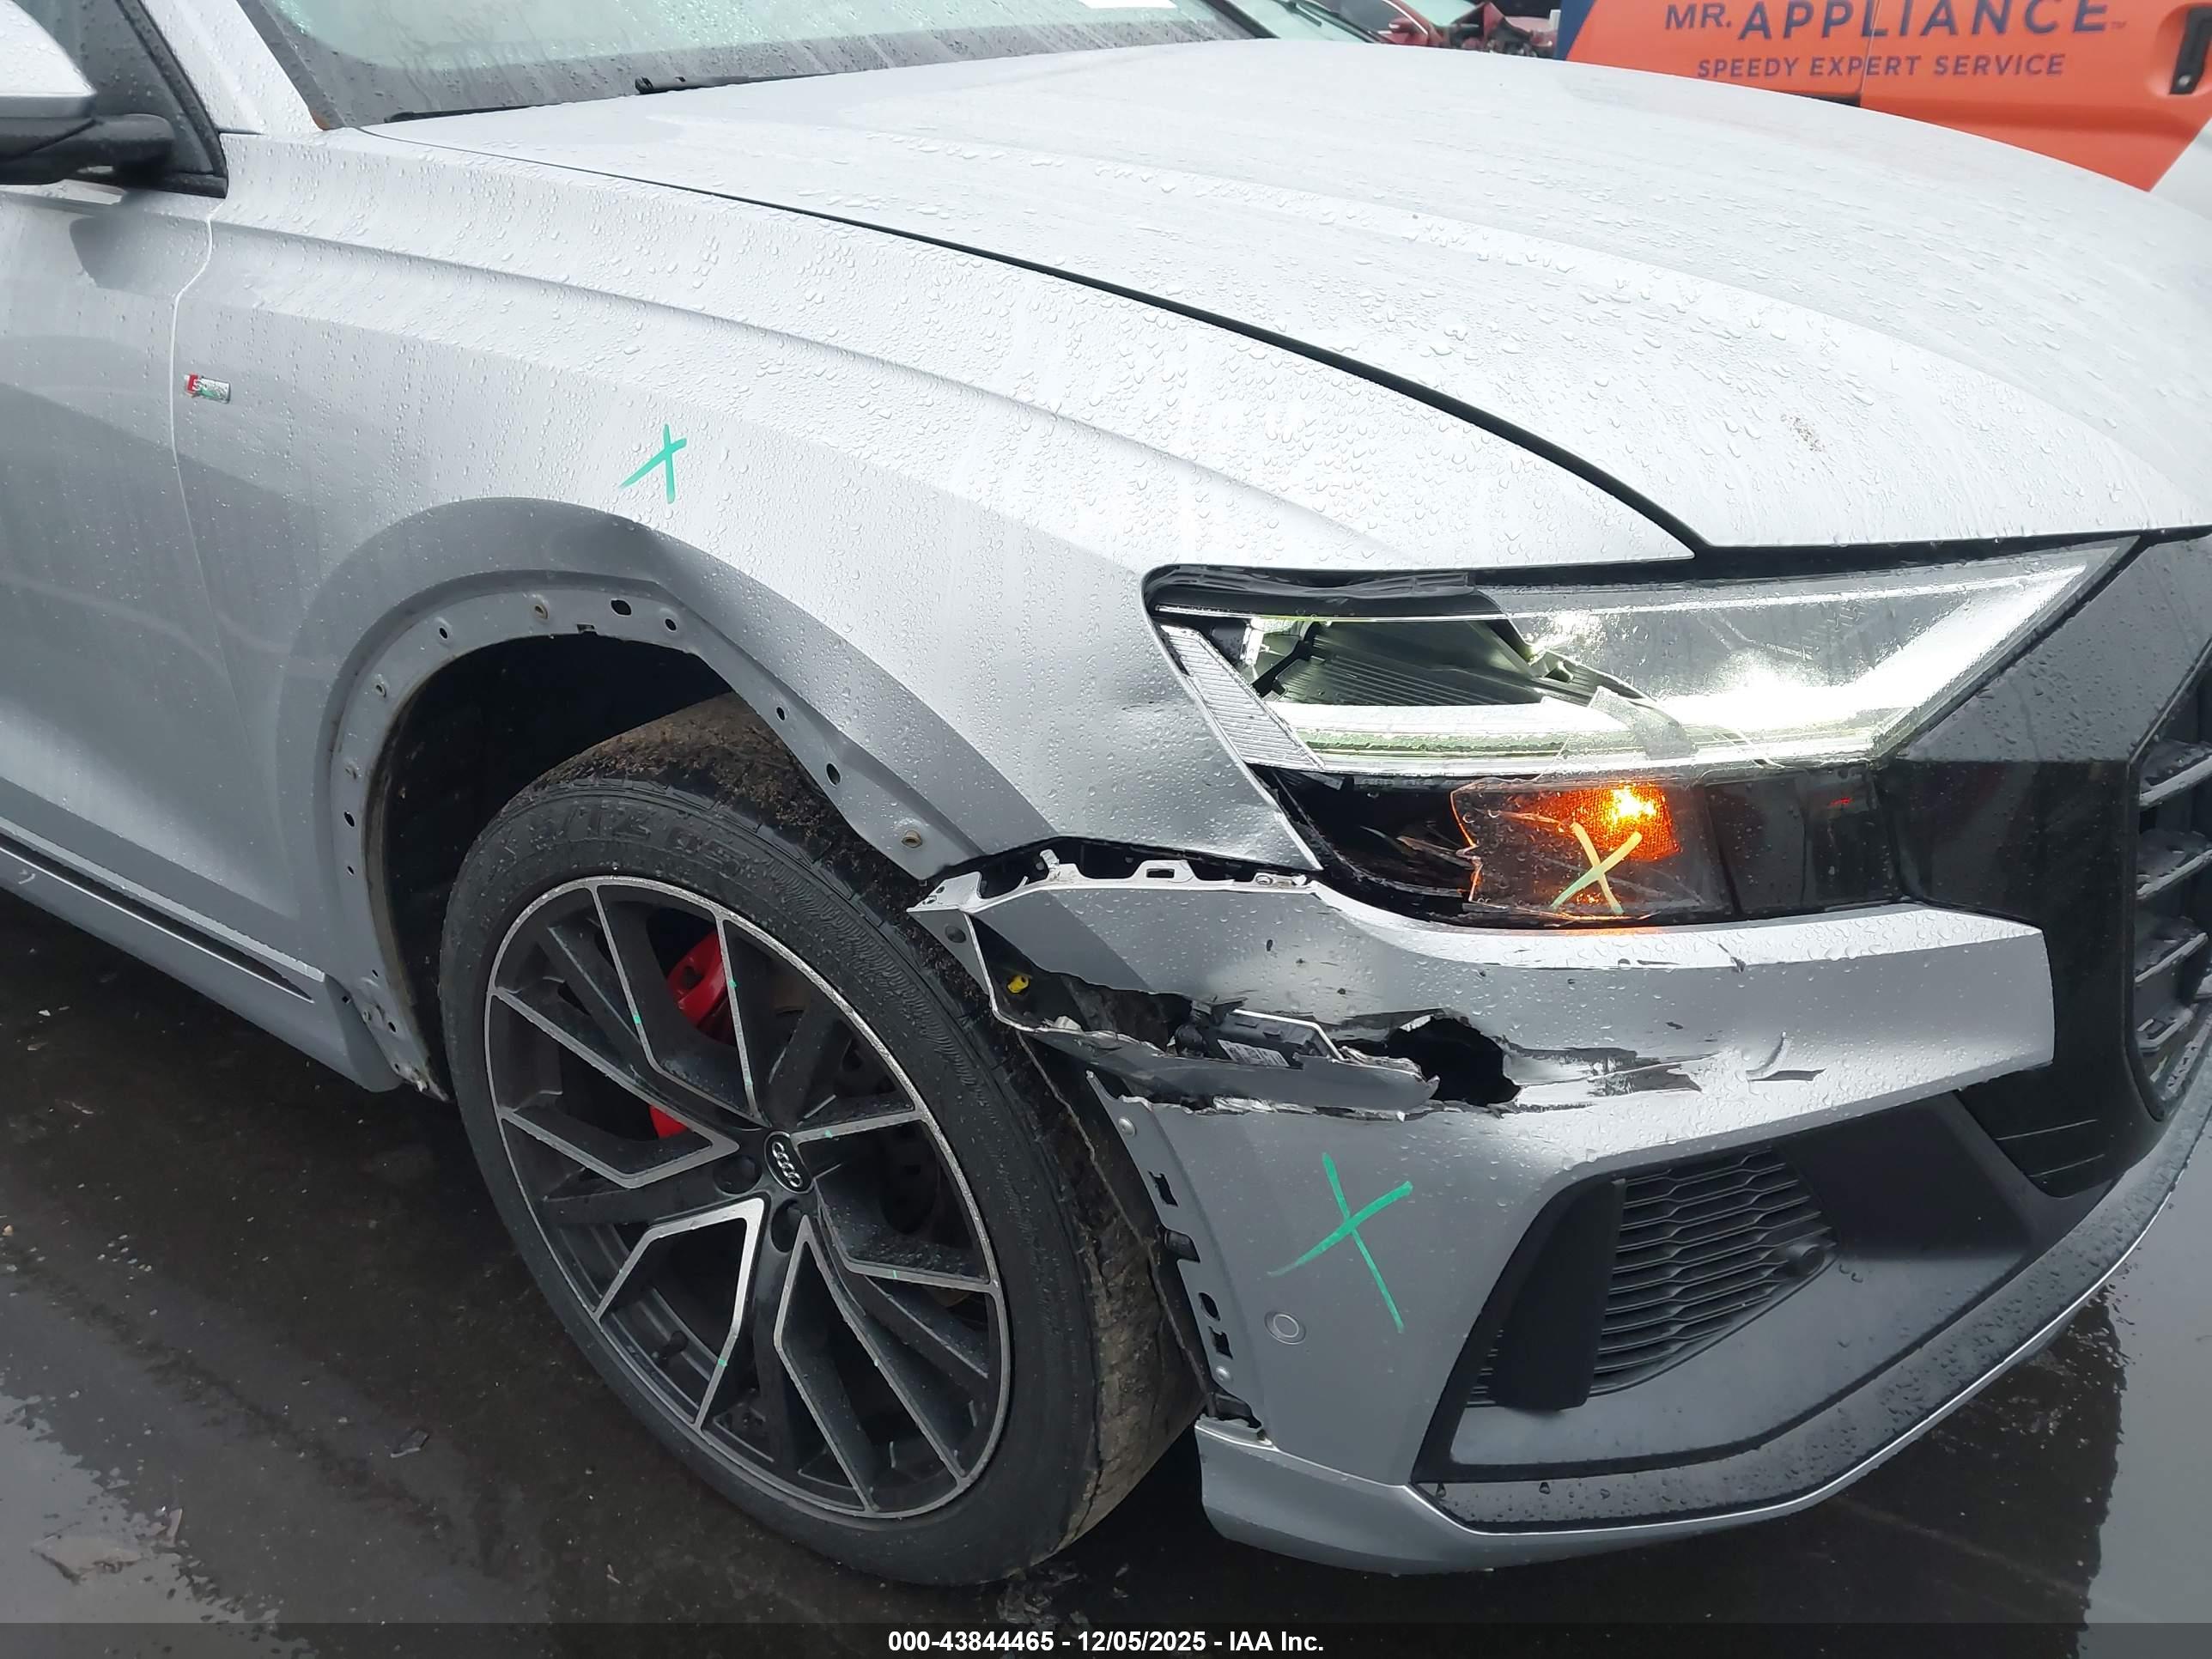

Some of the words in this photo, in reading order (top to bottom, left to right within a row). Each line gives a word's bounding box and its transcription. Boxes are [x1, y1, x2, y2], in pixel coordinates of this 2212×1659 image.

[1665, 3, 1732, 29] MR.
[1737, 0, 2108, 40] APPLIANCE
[1698, 57, 1800, 78] SPEEDY
[1809, 55, 1922, 76] EXPERT
[1933, 53, 2065, 76] SERVICE
